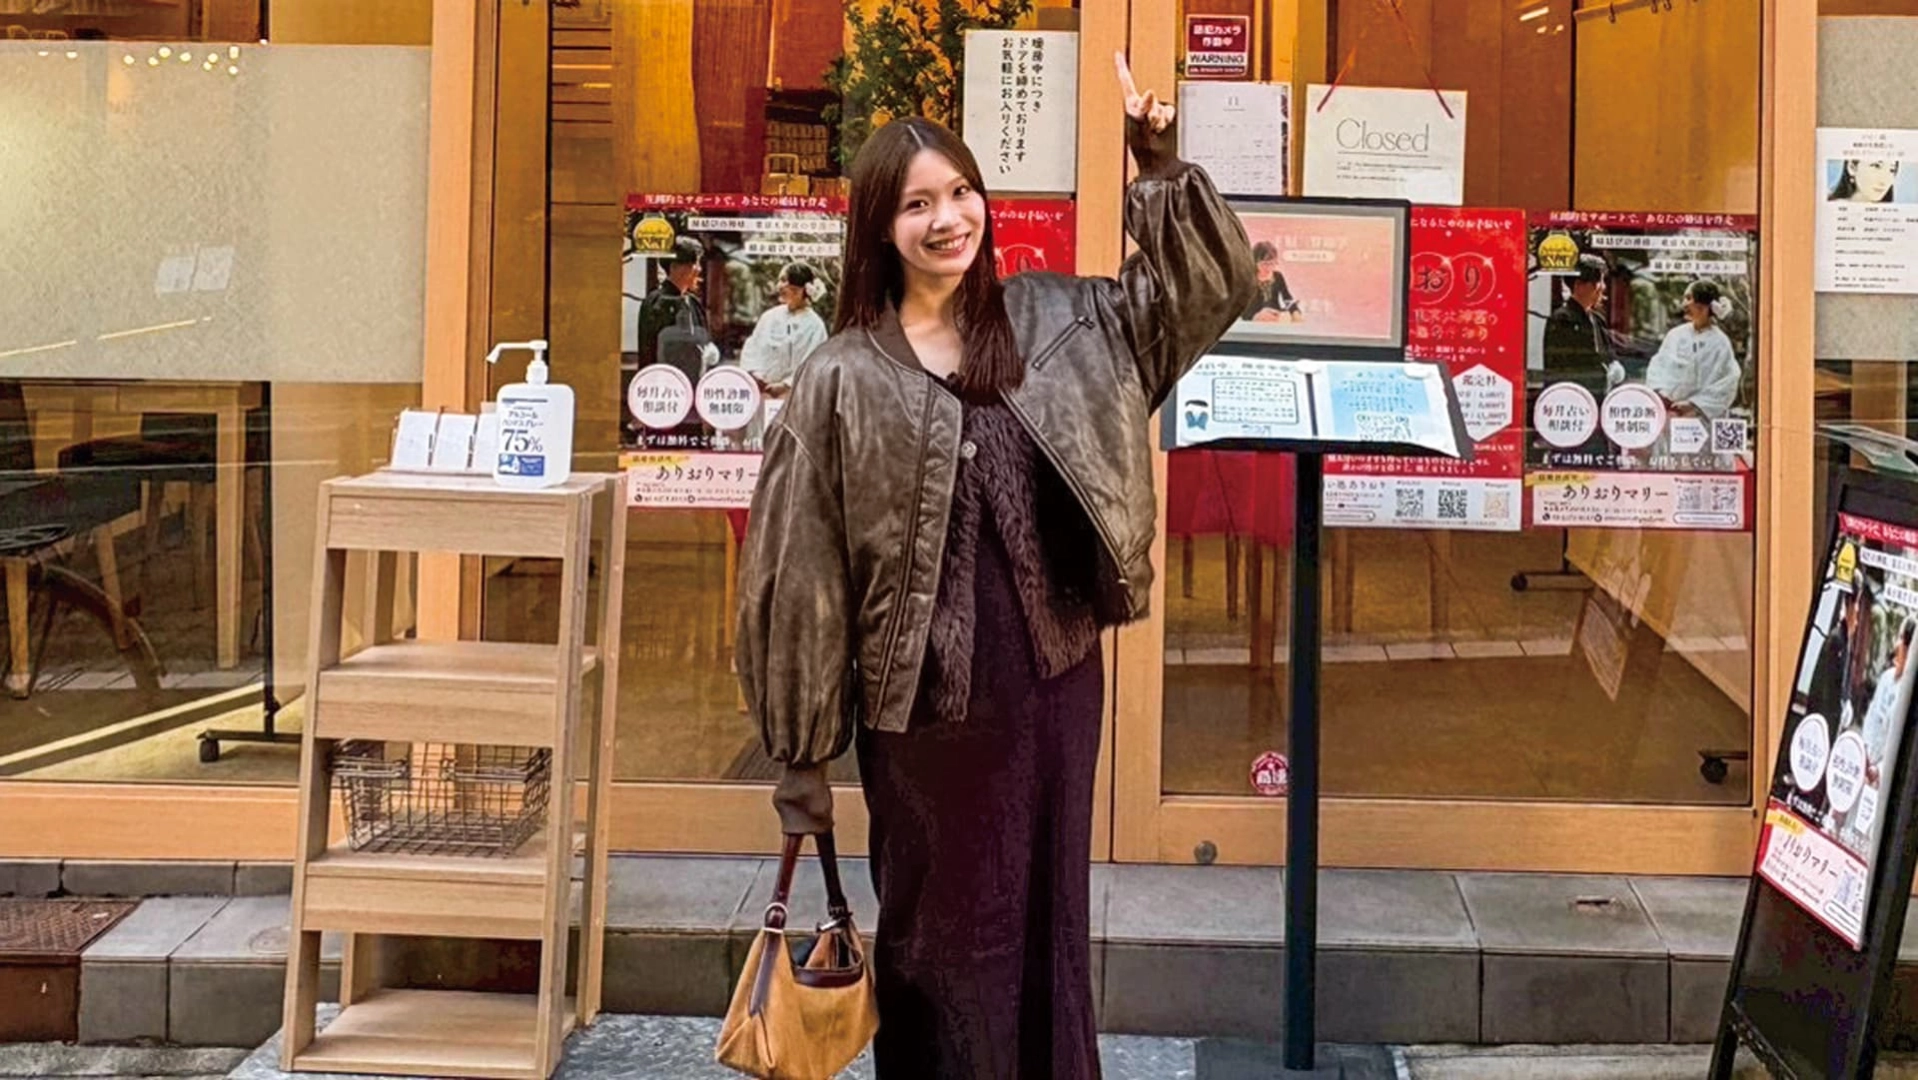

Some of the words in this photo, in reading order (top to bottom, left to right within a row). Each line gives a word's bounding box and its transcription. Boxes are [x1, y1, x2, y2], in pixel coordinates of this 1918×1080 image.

[1190, 54, 1244, 64] WARNING
[1031, 36, 1044, 112] 暖房中につき
[999, 36, 1013, 175] お気軽にお入りください
[1015, 36, 1028, 163] ドアを締めております
[1336, 117, 1430, 152] Closed
[1609, 406, 1656, 419] 相性診断
[1615, 421, 1650, 434] 無制限
[502, 428, 544, 452] 75%
[1562, 484, 1669, 501] ありおりマリー
